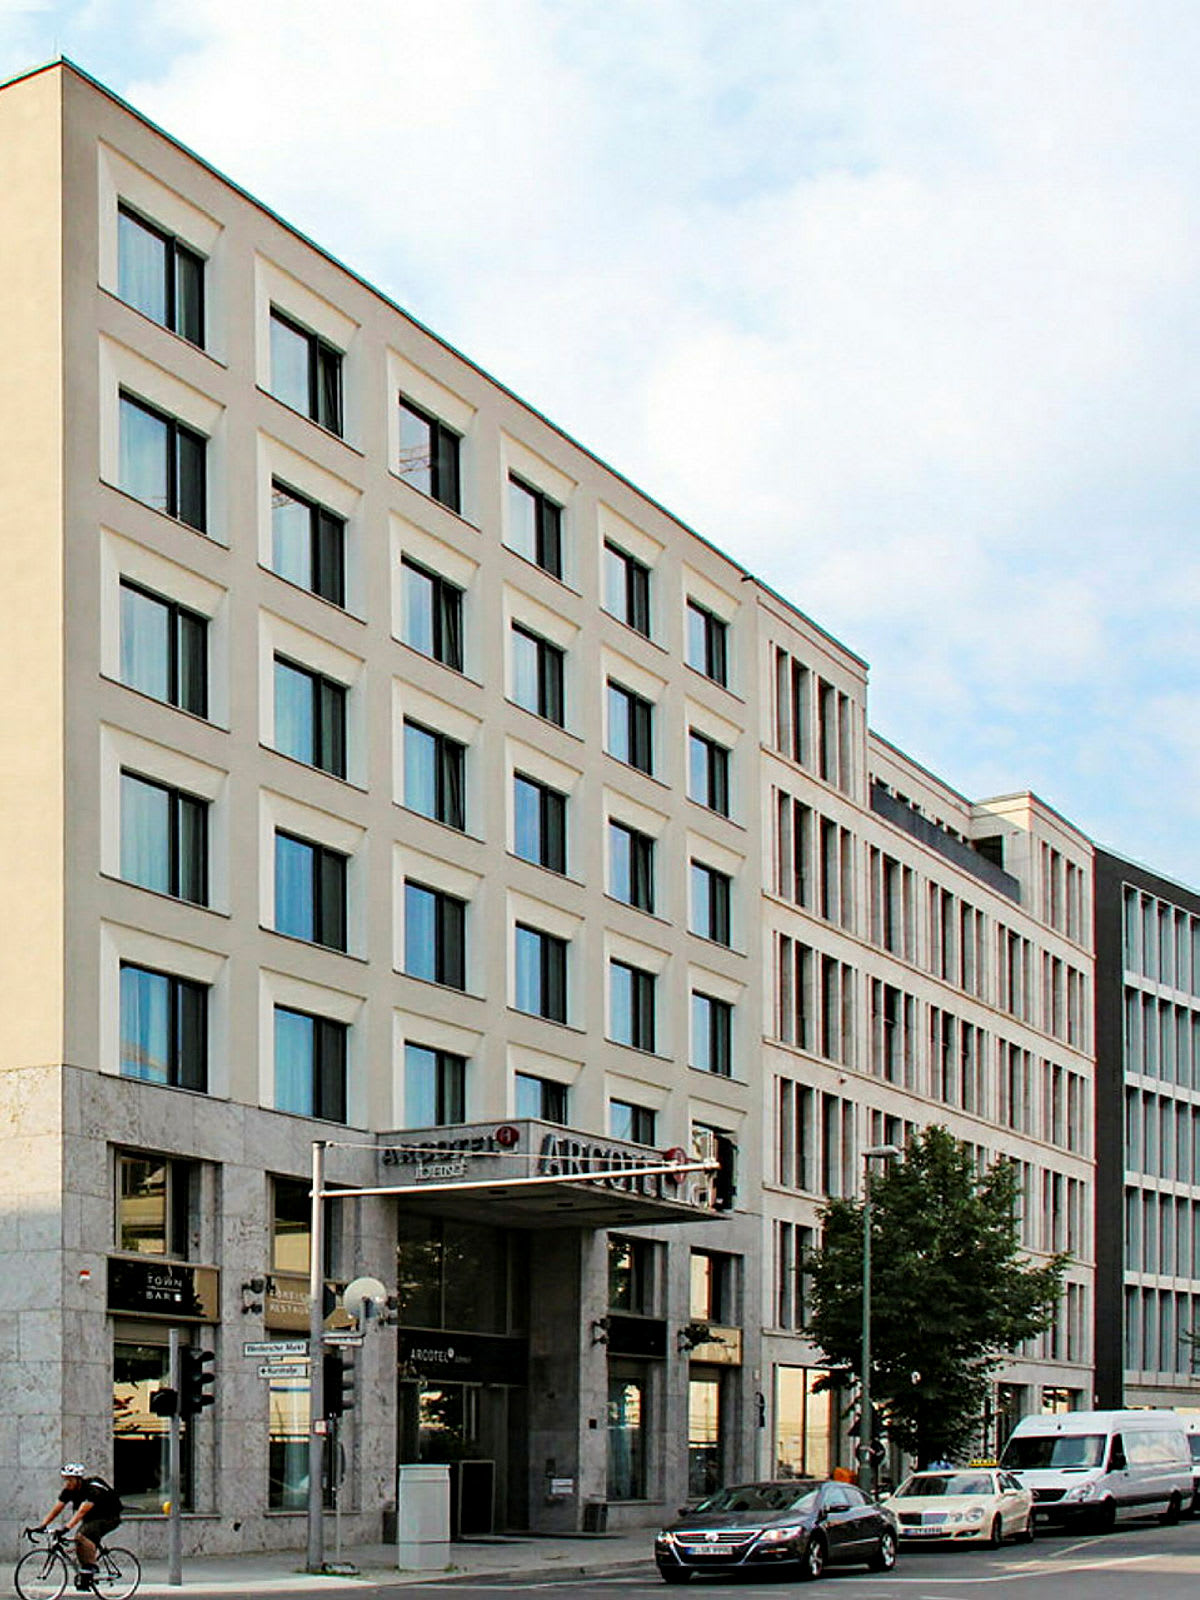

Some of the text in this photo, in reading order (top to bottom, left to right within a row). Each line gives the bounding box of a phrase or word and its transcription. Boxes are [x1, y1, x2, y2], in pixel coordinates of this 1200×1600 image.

[147, 1275, 183, 1288] TOWN
[145, 1291, 171, 1301] BAR
[410, 1348, 449, 1364] ARCOTEL
